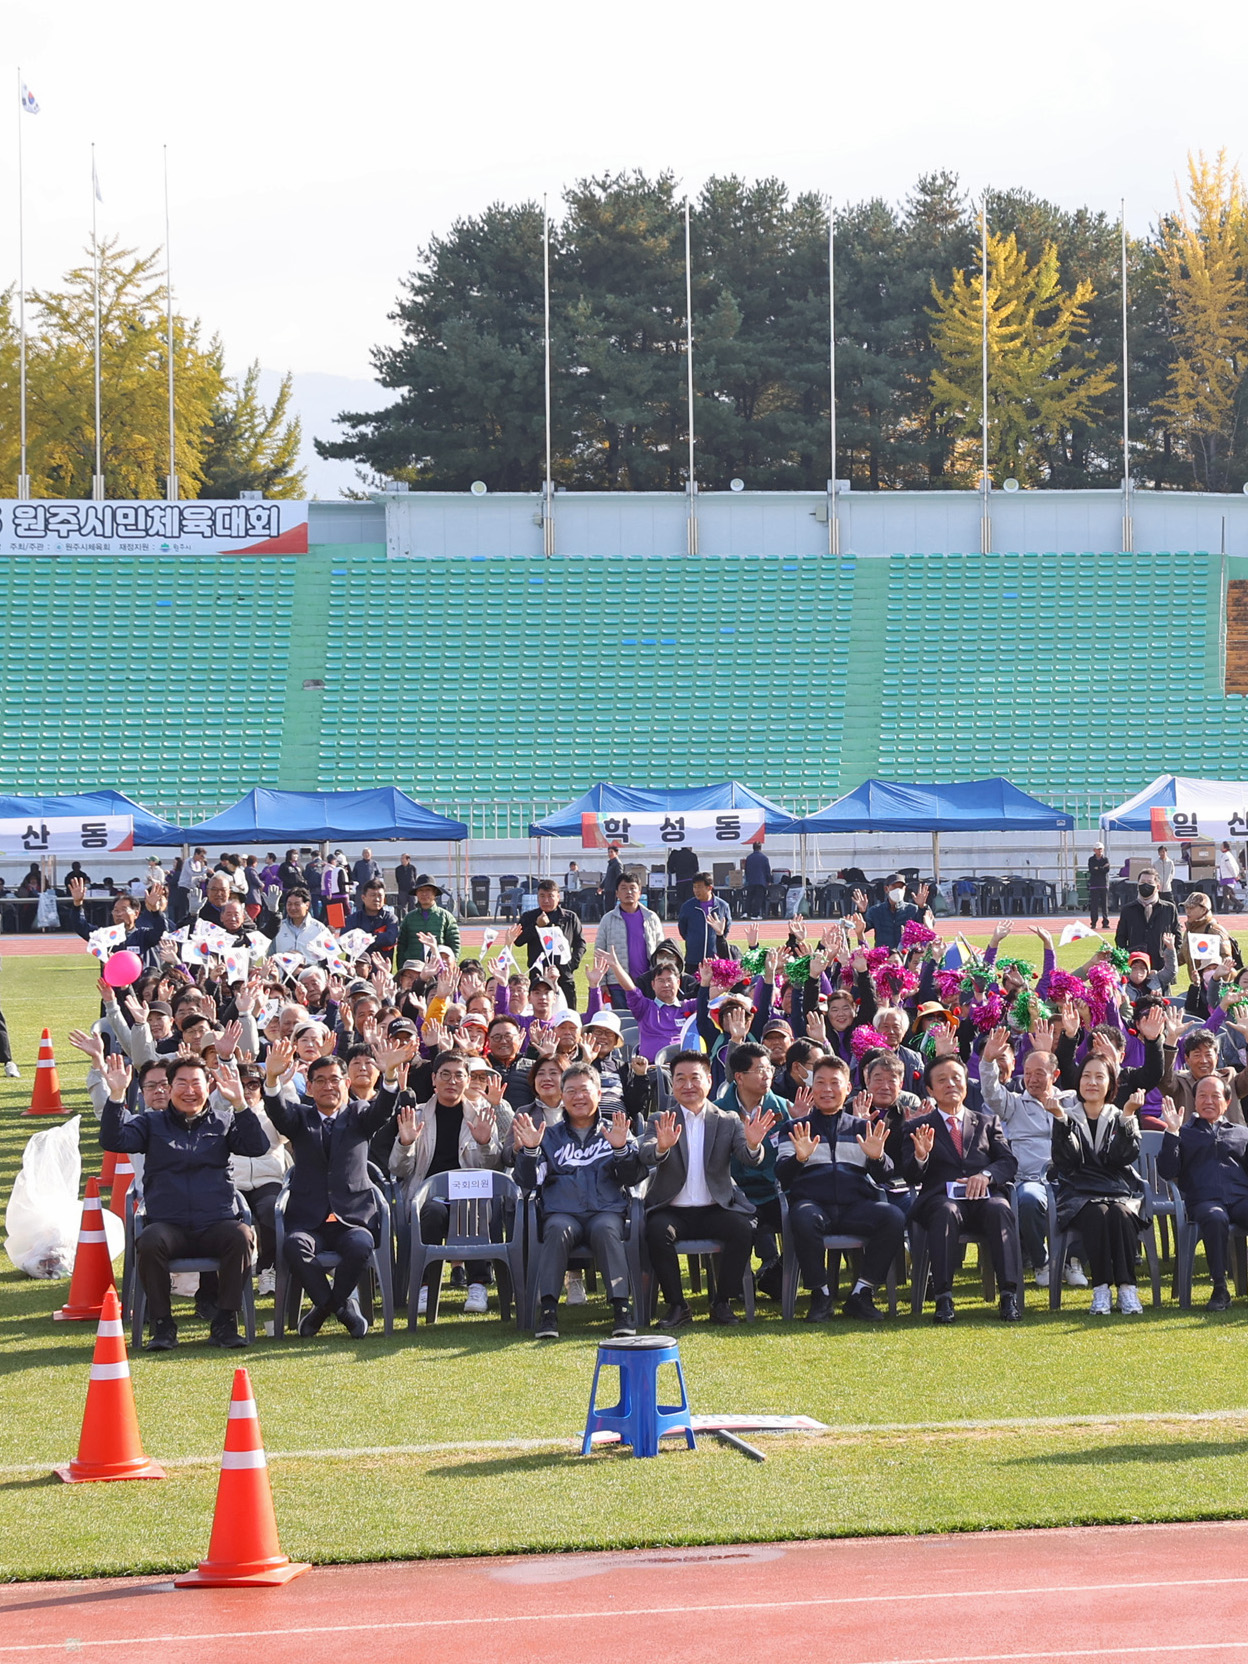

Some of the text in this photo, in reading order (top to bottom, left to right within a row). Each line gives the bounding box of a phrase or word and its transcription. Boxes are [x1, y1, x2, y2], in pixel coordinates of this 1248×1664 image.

[12, 504, 280, 539] 원주시민체육대회
[603, 815, 741, 844] 학성동
[452, 1179, 489, 1189] 국회의원
